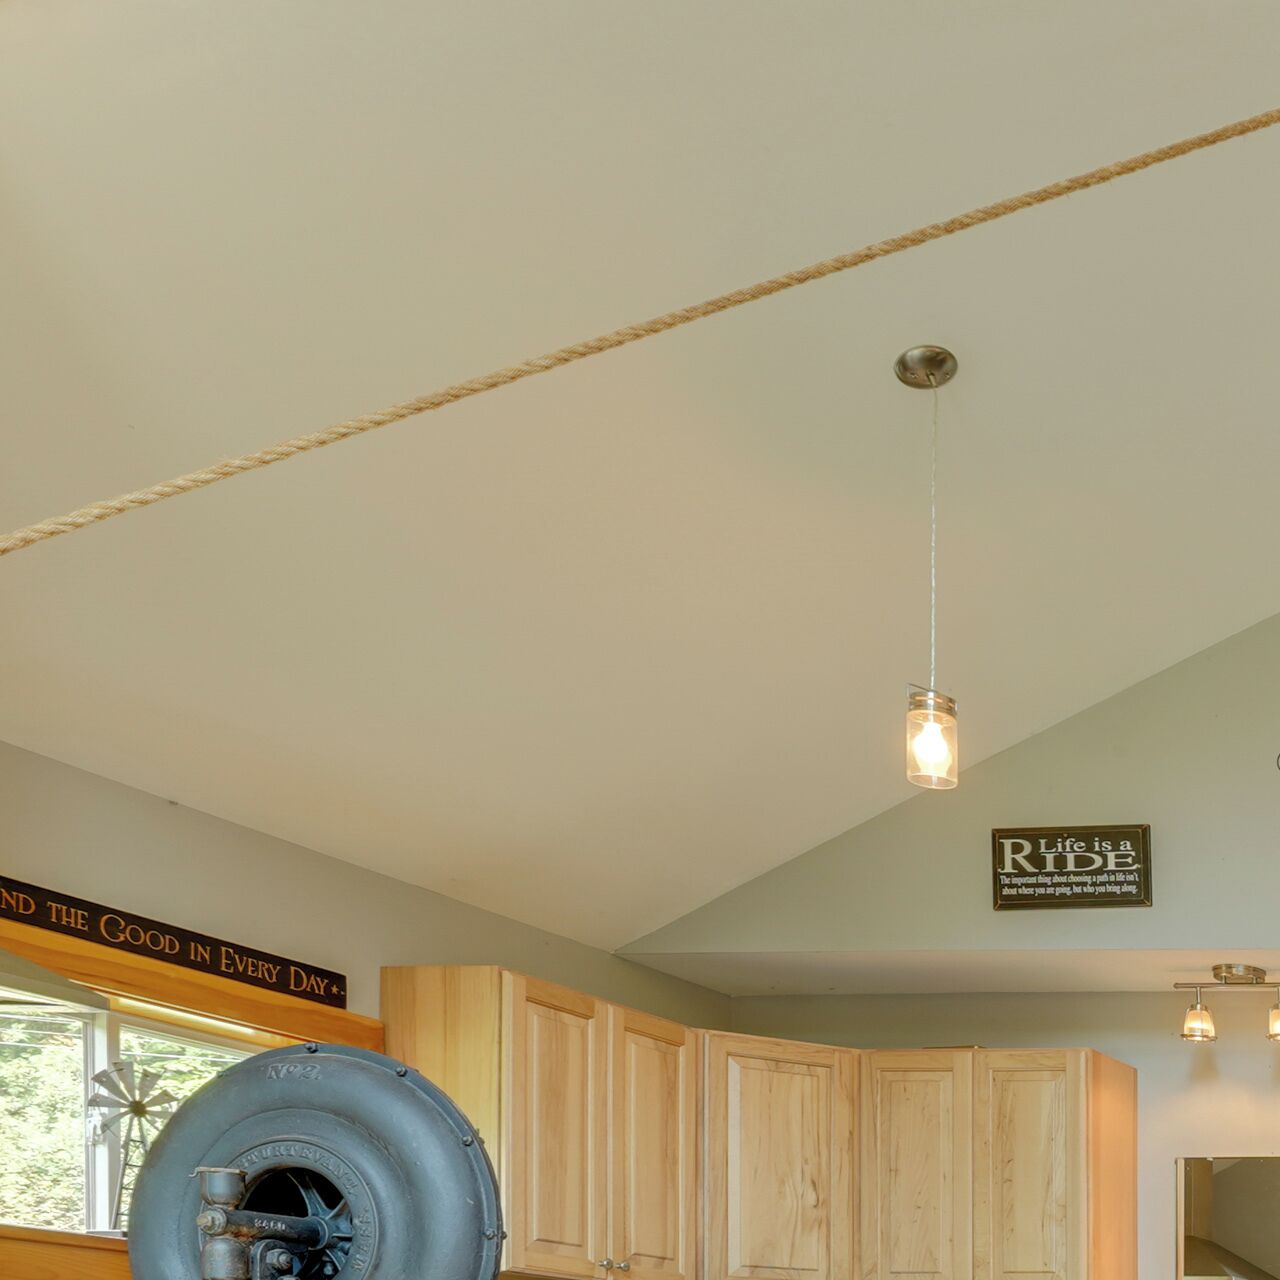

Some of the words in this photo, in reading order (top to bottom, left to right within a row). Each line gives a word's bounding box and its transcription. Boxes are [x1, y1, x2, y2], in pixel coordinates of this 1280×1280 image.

[1038, 837, 1087, 853] Life
[1093, 836, 1112, 851] is
[1119, 839, 1134, 851] a
[998, 838, 1139, 873] RIDE
[1000, 875, 1011, 885] The
[1038, 874, 1052, 885] thing
[1052, 874, 1067, 883] about
[1067, 873, 1092, 885] choosing
[1002, 886, 1017, 895] about
[1035, 887, 1045, 897] you
[1095, 885, 1105, 895] you
[0, 888, 36, 915] ND
[46, 901, 89, 931] THE
[189, 941, 211, 965] IN
